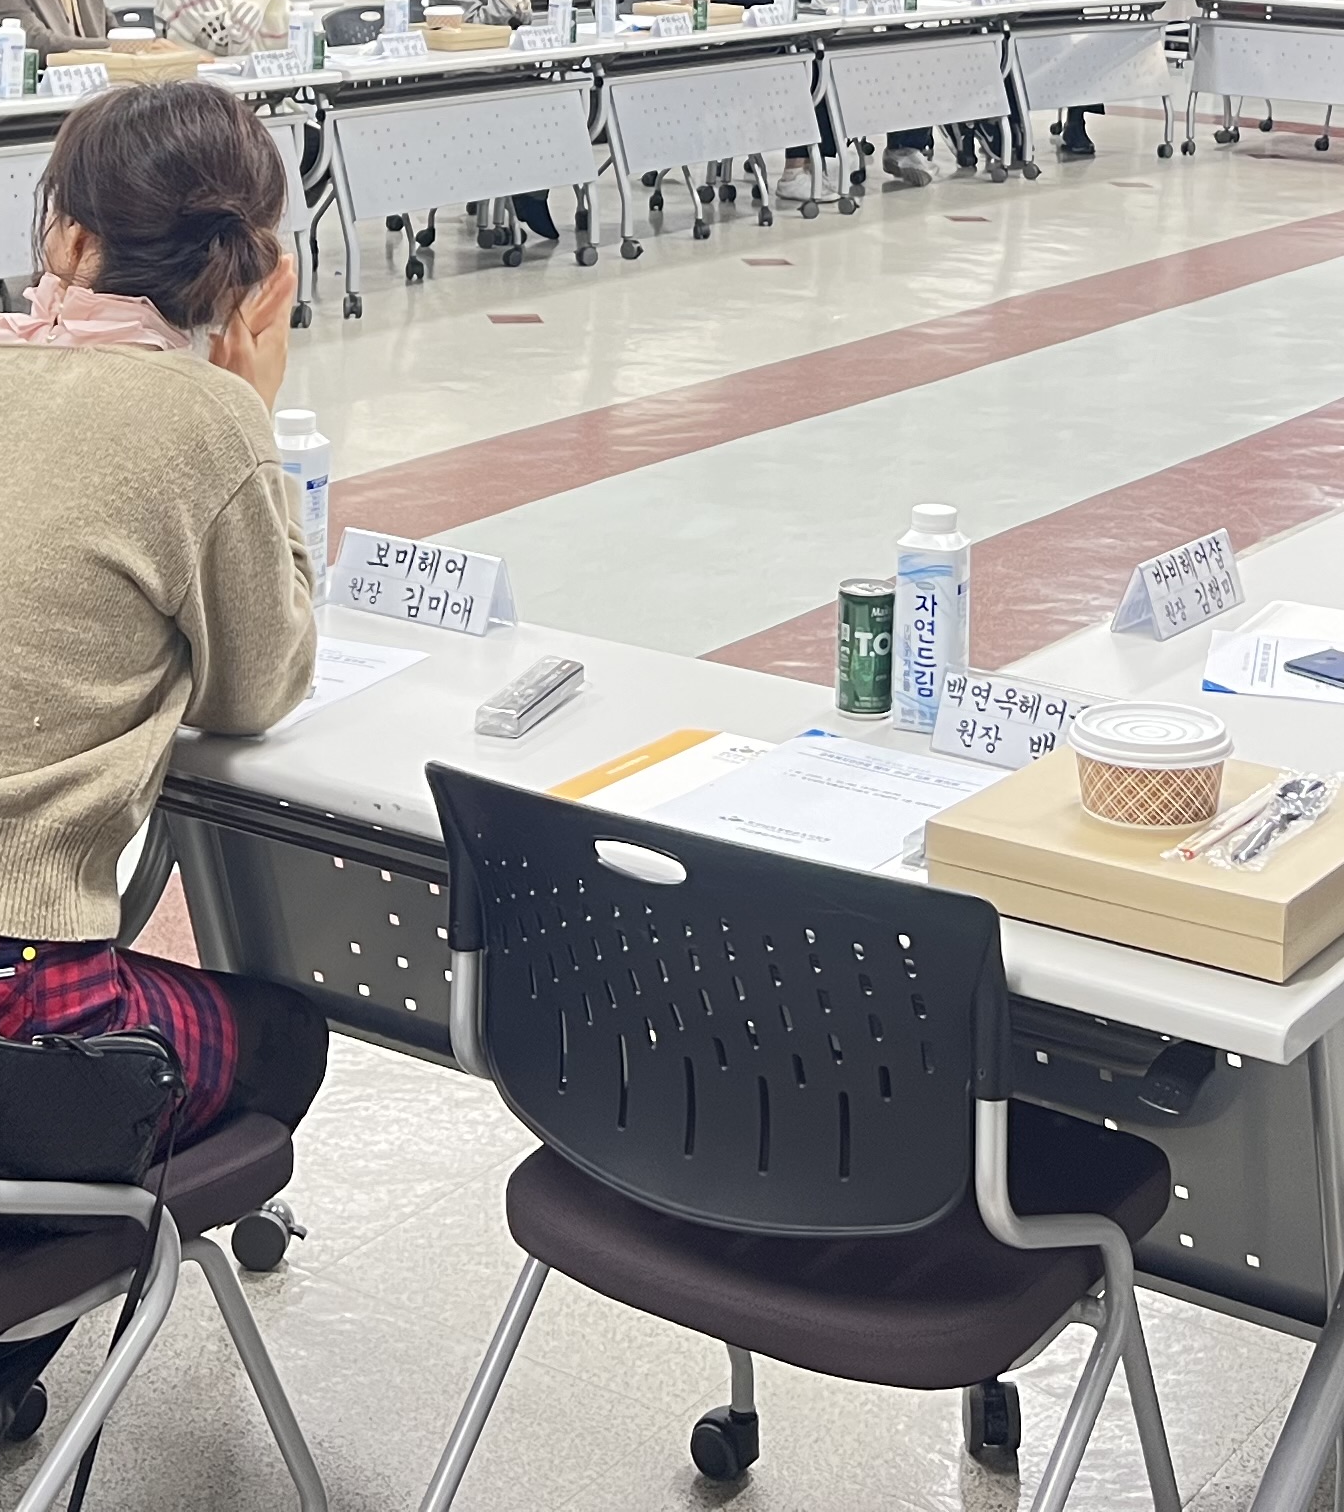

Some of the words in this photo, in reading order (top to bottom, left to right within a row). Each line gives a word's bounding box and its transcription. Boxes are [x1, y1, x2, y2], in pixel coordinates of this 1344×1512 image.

[366, 541, 468, 590] 보미헤어
[348, 576, 383, 605] 원장
[401, 583, 475, 631] 김미애
[1164, 596, 1187, 626] 원장
[913, 593, 939, 699] 자연드림
[946, 675, 1090, 731] 백연옥헤어
[956, 718, 1003, 754] 원장
